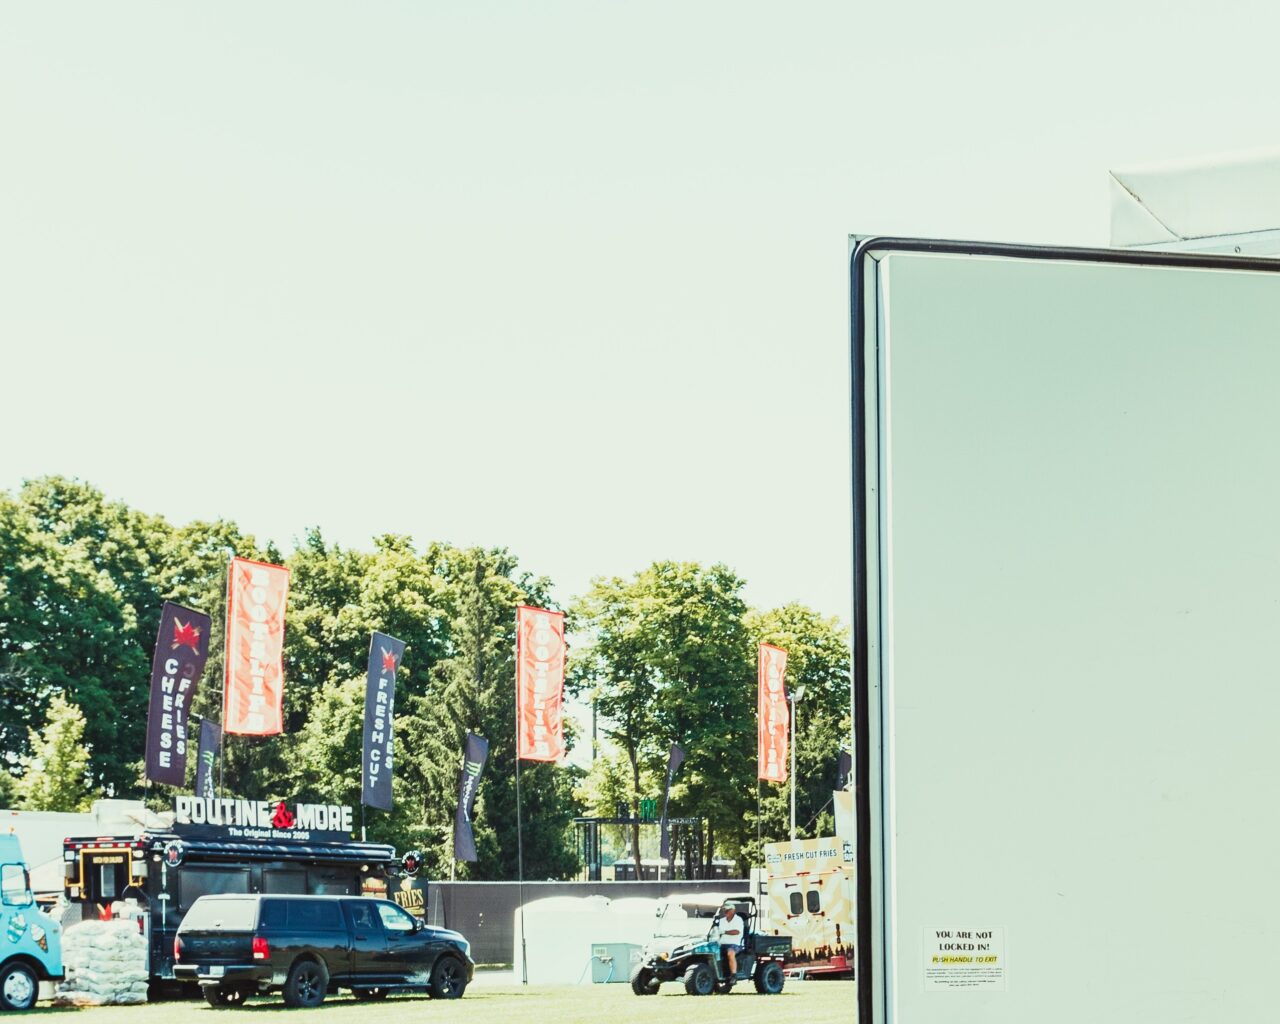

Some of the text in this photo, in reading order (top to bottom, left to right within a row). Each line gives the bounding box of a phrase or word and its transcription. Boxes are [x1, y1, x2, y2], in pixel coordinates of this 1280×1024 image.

[159, 658, 179, 768] CHEESE
[175, 678, 192, 755] FRIES
[369, 678, 389, 788] FRESH CUT
[176, 796, 353, 832] POUTINE & MORE
[228, 827, 243, 836] The
[243, 828, 271, 839] Original
[272, 829, 292, 839] Since
[784, 852, 804, 861] FRESH
[805, 850, 818, 860] CUT
[820, 848, 837, 858] FRIES
[394, 888, 424, 908] FRIES
[936, 930, 993, 939] YOU ARE NOT
[939, 943, 990, 951] LOCKED IN!
